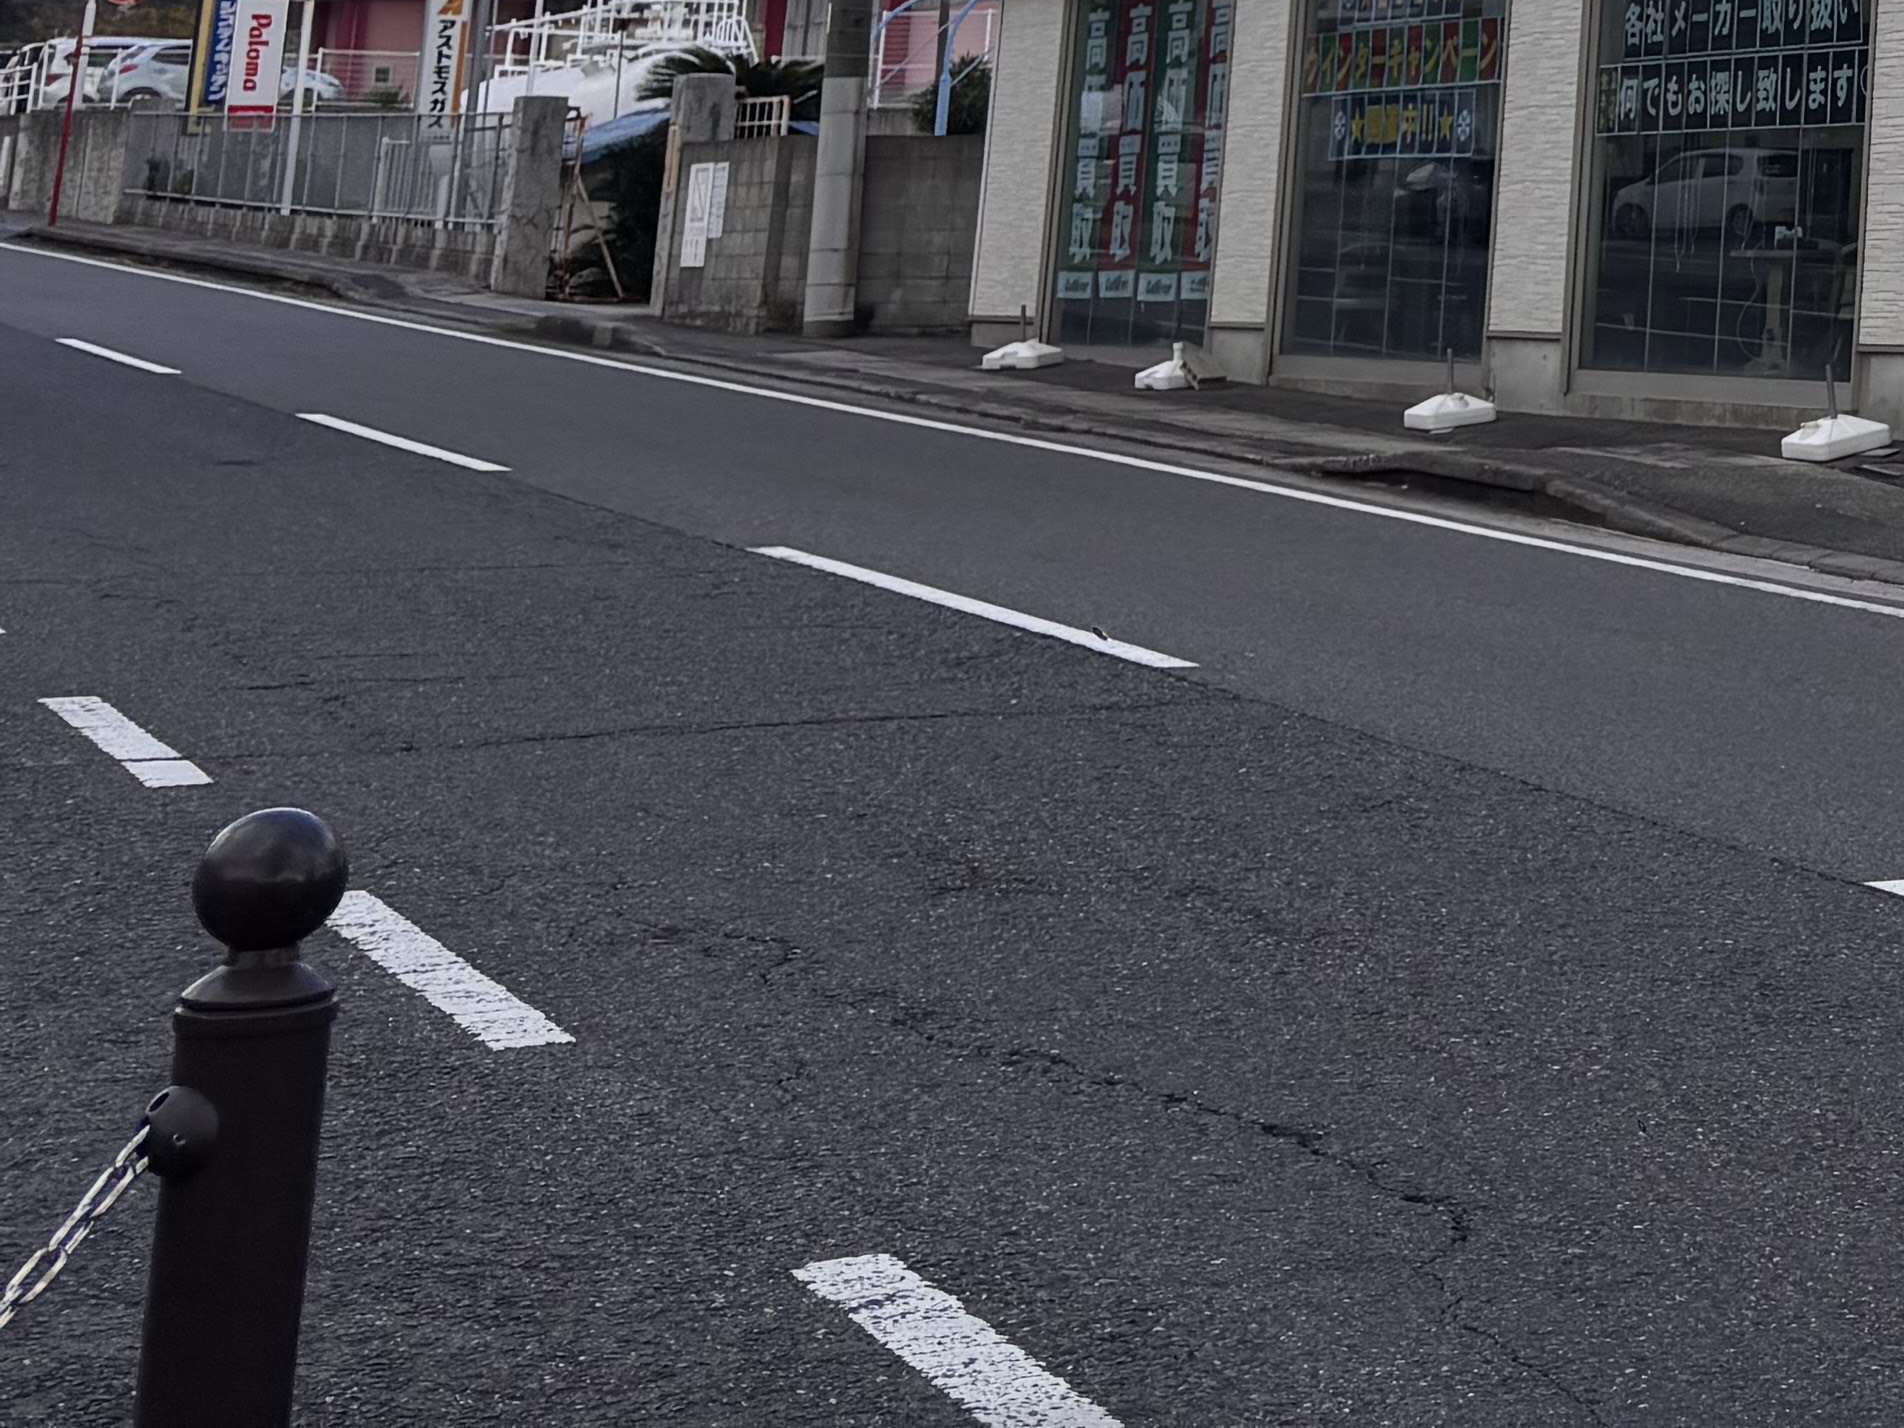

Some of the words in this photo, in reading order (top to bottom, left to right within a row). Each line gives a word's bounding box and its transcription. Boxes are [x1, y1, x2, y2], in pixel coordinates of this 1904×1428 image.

[242, 13, 272, 92] Paloma
[427, 19, 456, 129] アストモスガス
[1620, 63, 1854, 120] 何でもお探し致します
[1069, 7, 1110, 264] 高買取
[1110, 2, 1153, 263] 高価買取
